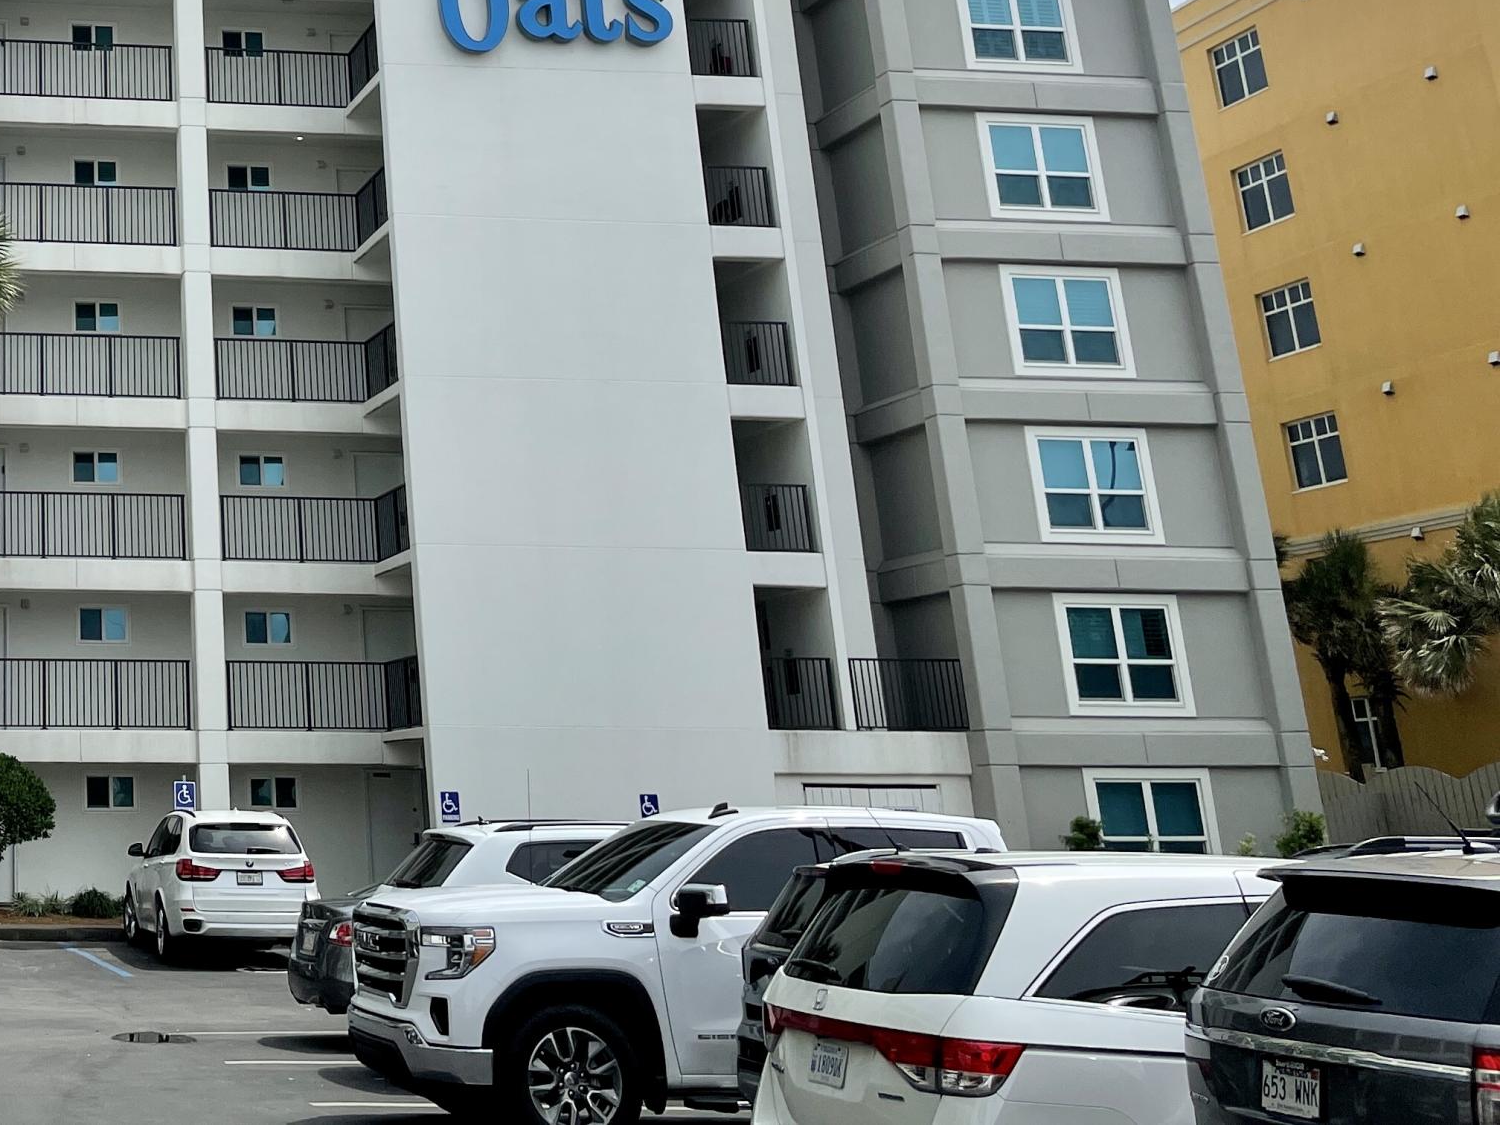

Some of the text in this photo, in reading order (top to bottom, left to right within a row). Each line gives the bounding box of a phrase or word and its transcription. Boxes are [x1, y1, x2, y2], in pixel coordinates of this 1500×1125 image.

[1264, 1009, 1285, 1026] Ford
[1263, 1075, 1318, 1107] 653 WNK
